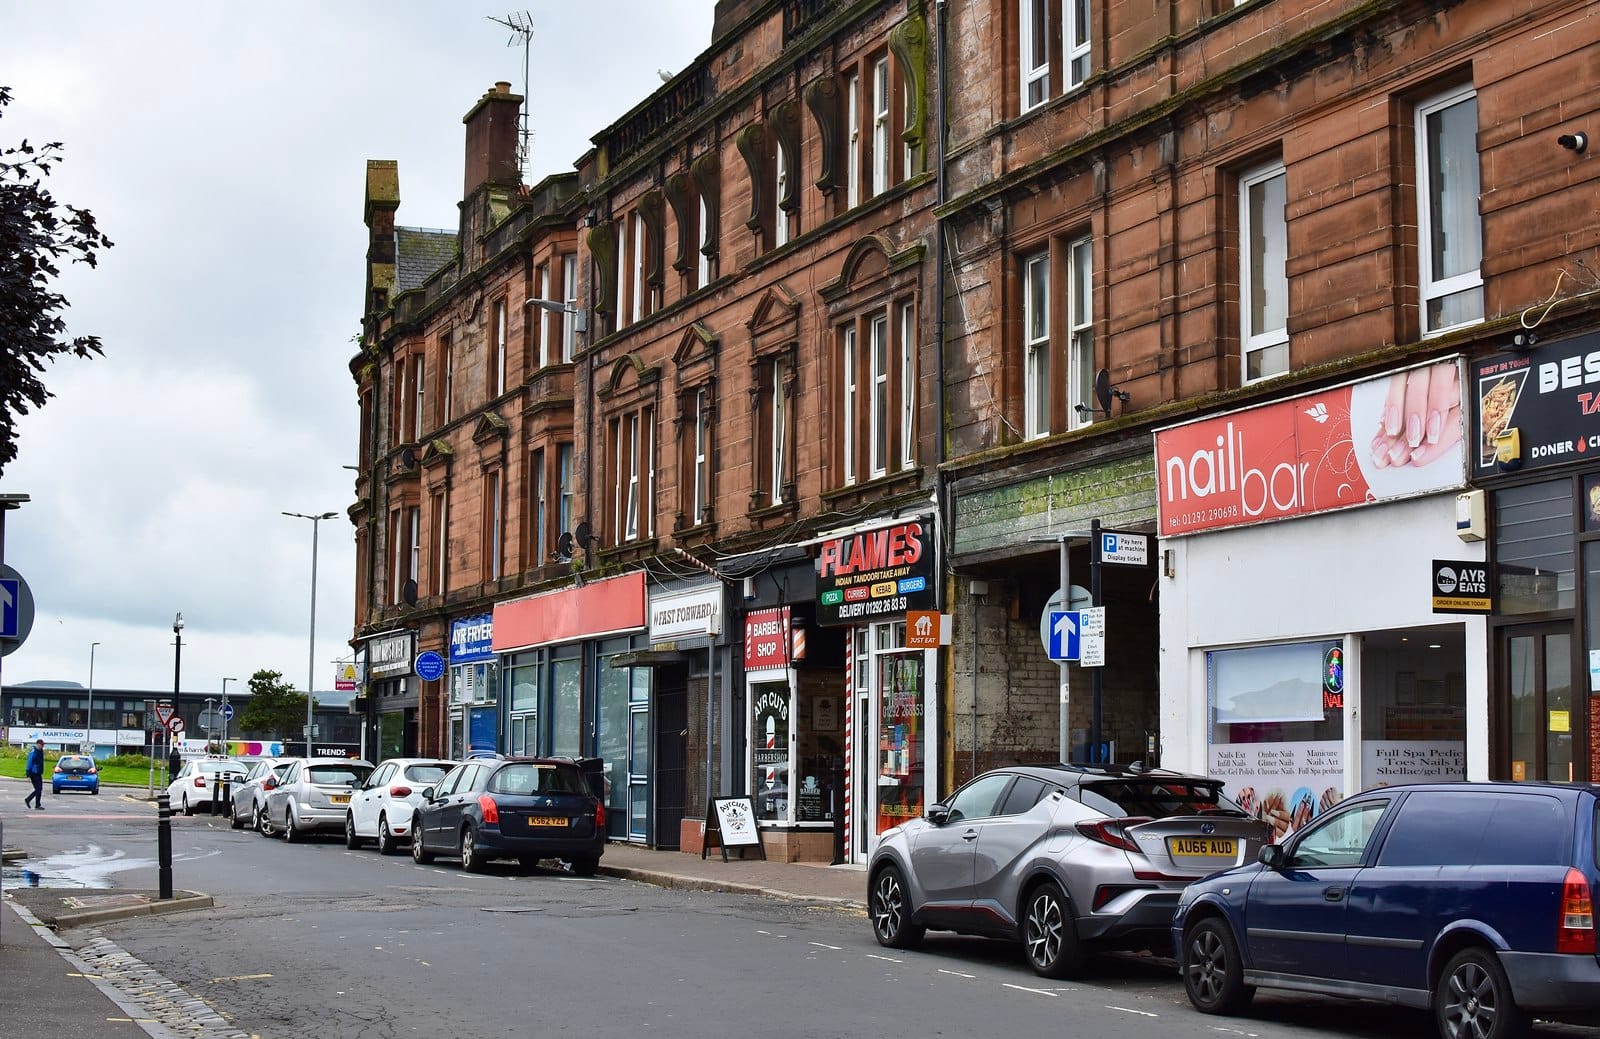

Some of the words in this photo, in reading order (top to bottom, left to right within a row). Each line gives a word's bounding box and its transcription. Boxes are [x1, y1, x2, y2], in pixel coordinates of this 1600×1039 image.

[1531, 440, 1574, 458] DONER
[1166, 422, 1236, 502] nail
[1238, 431, 1310, 517] bar
[1169, 517, 1180, 527] tel:
[1182, 510, 1206, 525] 01292
[1208, 504, 1238, 520] 290698
[1120, 538, 1130, 546] Pay
[820, 523, 923, 578] FLAMES
[1107, 554, 1126, 562] Display
[835, 576, 852, 587] INDIAN
[853, 571, 880, 584] TANDOORI
[1459, 569, 1486, 582] AYR
[875, 584, 892, 595] KEBAB
[900, 579, 923, 591] BURGERS
[1459, 582, 1486, 593] EATS
[826, 592, 838, 602] PIZZA
[847, 588, 867, 599] CURRIES
[839, 602, 865, 618] DELIVERY
[866, 600, 882, 615] 01292
[883, 599, 891, 612] 26
[891, 598, 898, 611] 83
[899, 596, 907, 610] 53
[658, 609, 676, 626] FAST
[676, 602, 711, 623] FORWARD
[452, 627, 467, 646] AYR
[757, 641, 777, 658] SHOP
[754, 693, 768, 720] AYR
[768, 691, 788, 720] CUTS
[316, 748, 346, 756] TRENDS
[1279, 750, 1295, 758] Nails
[1306, 749, 1338, 757] Manicure
[1376, 749, 1399, 757] Full
[1403, 749, 1426, 759] Spa
[1306, 758, 1325, 766] Nails
[1327, 758, 1339, 766] Art
[1384, 758, 1416, 766] Toes
[1420, 758, 1450, 766] Nails
[1310, 768, 1321, 776] Spa
[1376, 767, 1441, 776] Shellac/gel
[720, 801, 749, 813] Ayrcuts
[1178, 841, 1207, 853] AU66
[1211, 841, 1232, 854] AUD
